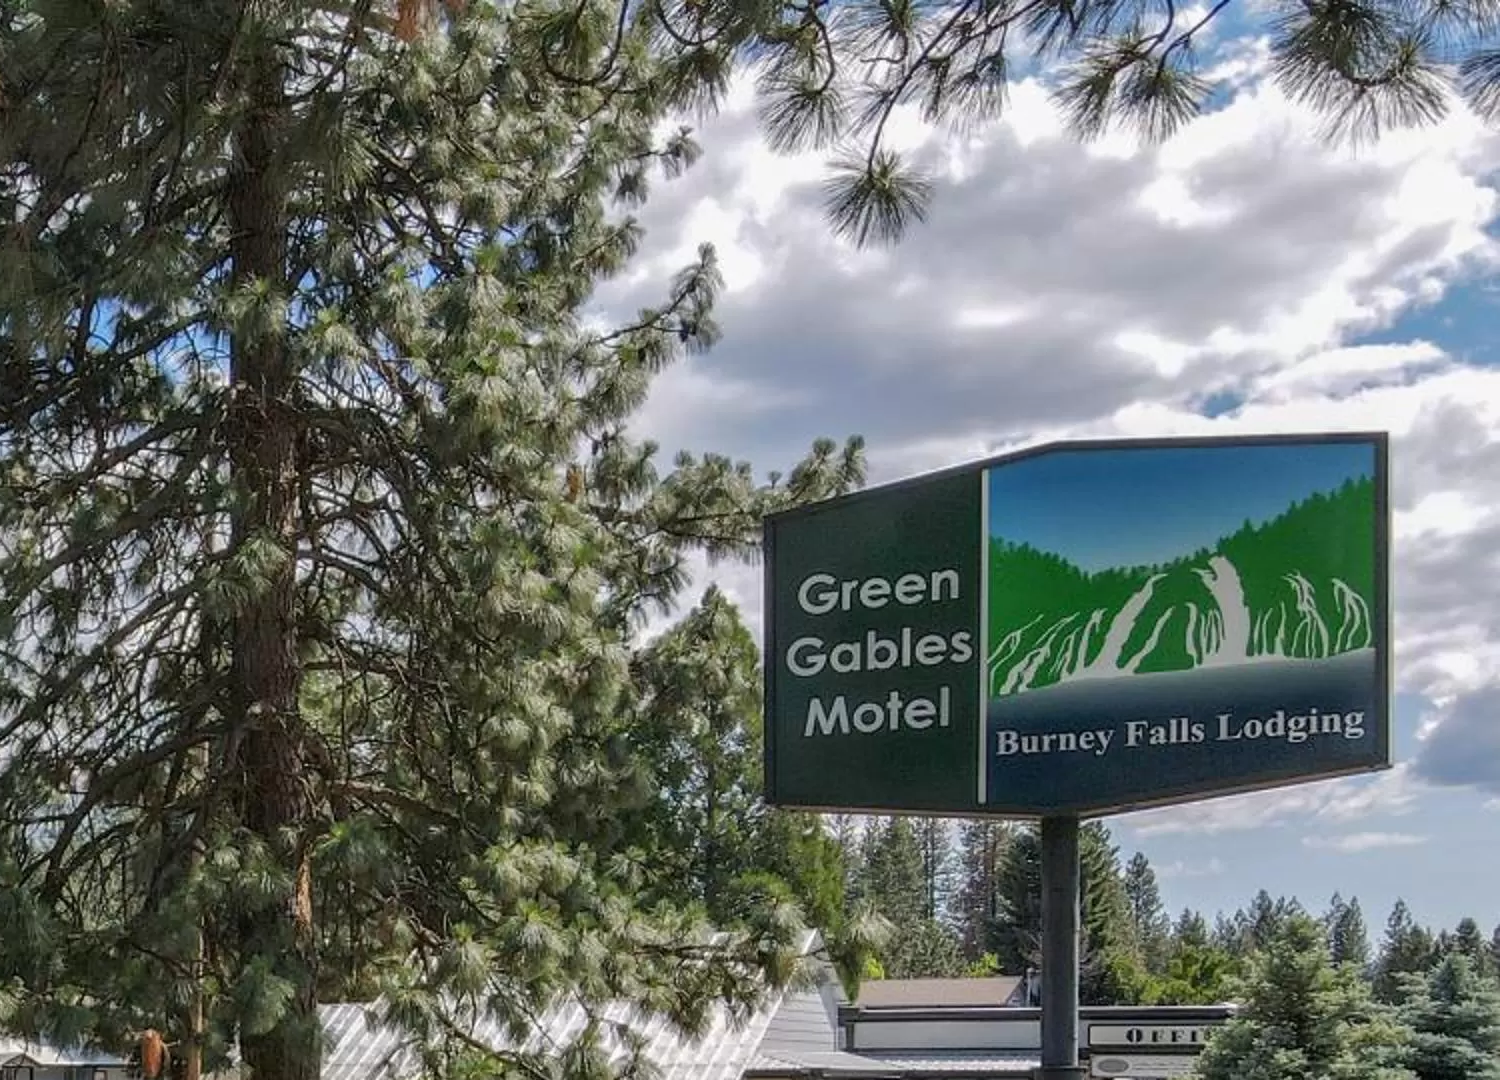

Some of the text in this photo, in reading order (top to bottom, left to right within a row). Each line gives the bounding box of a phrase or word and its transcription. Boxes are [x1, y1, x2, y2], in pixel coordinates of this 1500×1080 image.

[799, 567, 960, 615] Green
[786, 628, 973, 678] Gables
[804, 687, 949, 737] Motel
[996, 708, 1365, 756] Burney Falls Lodging
